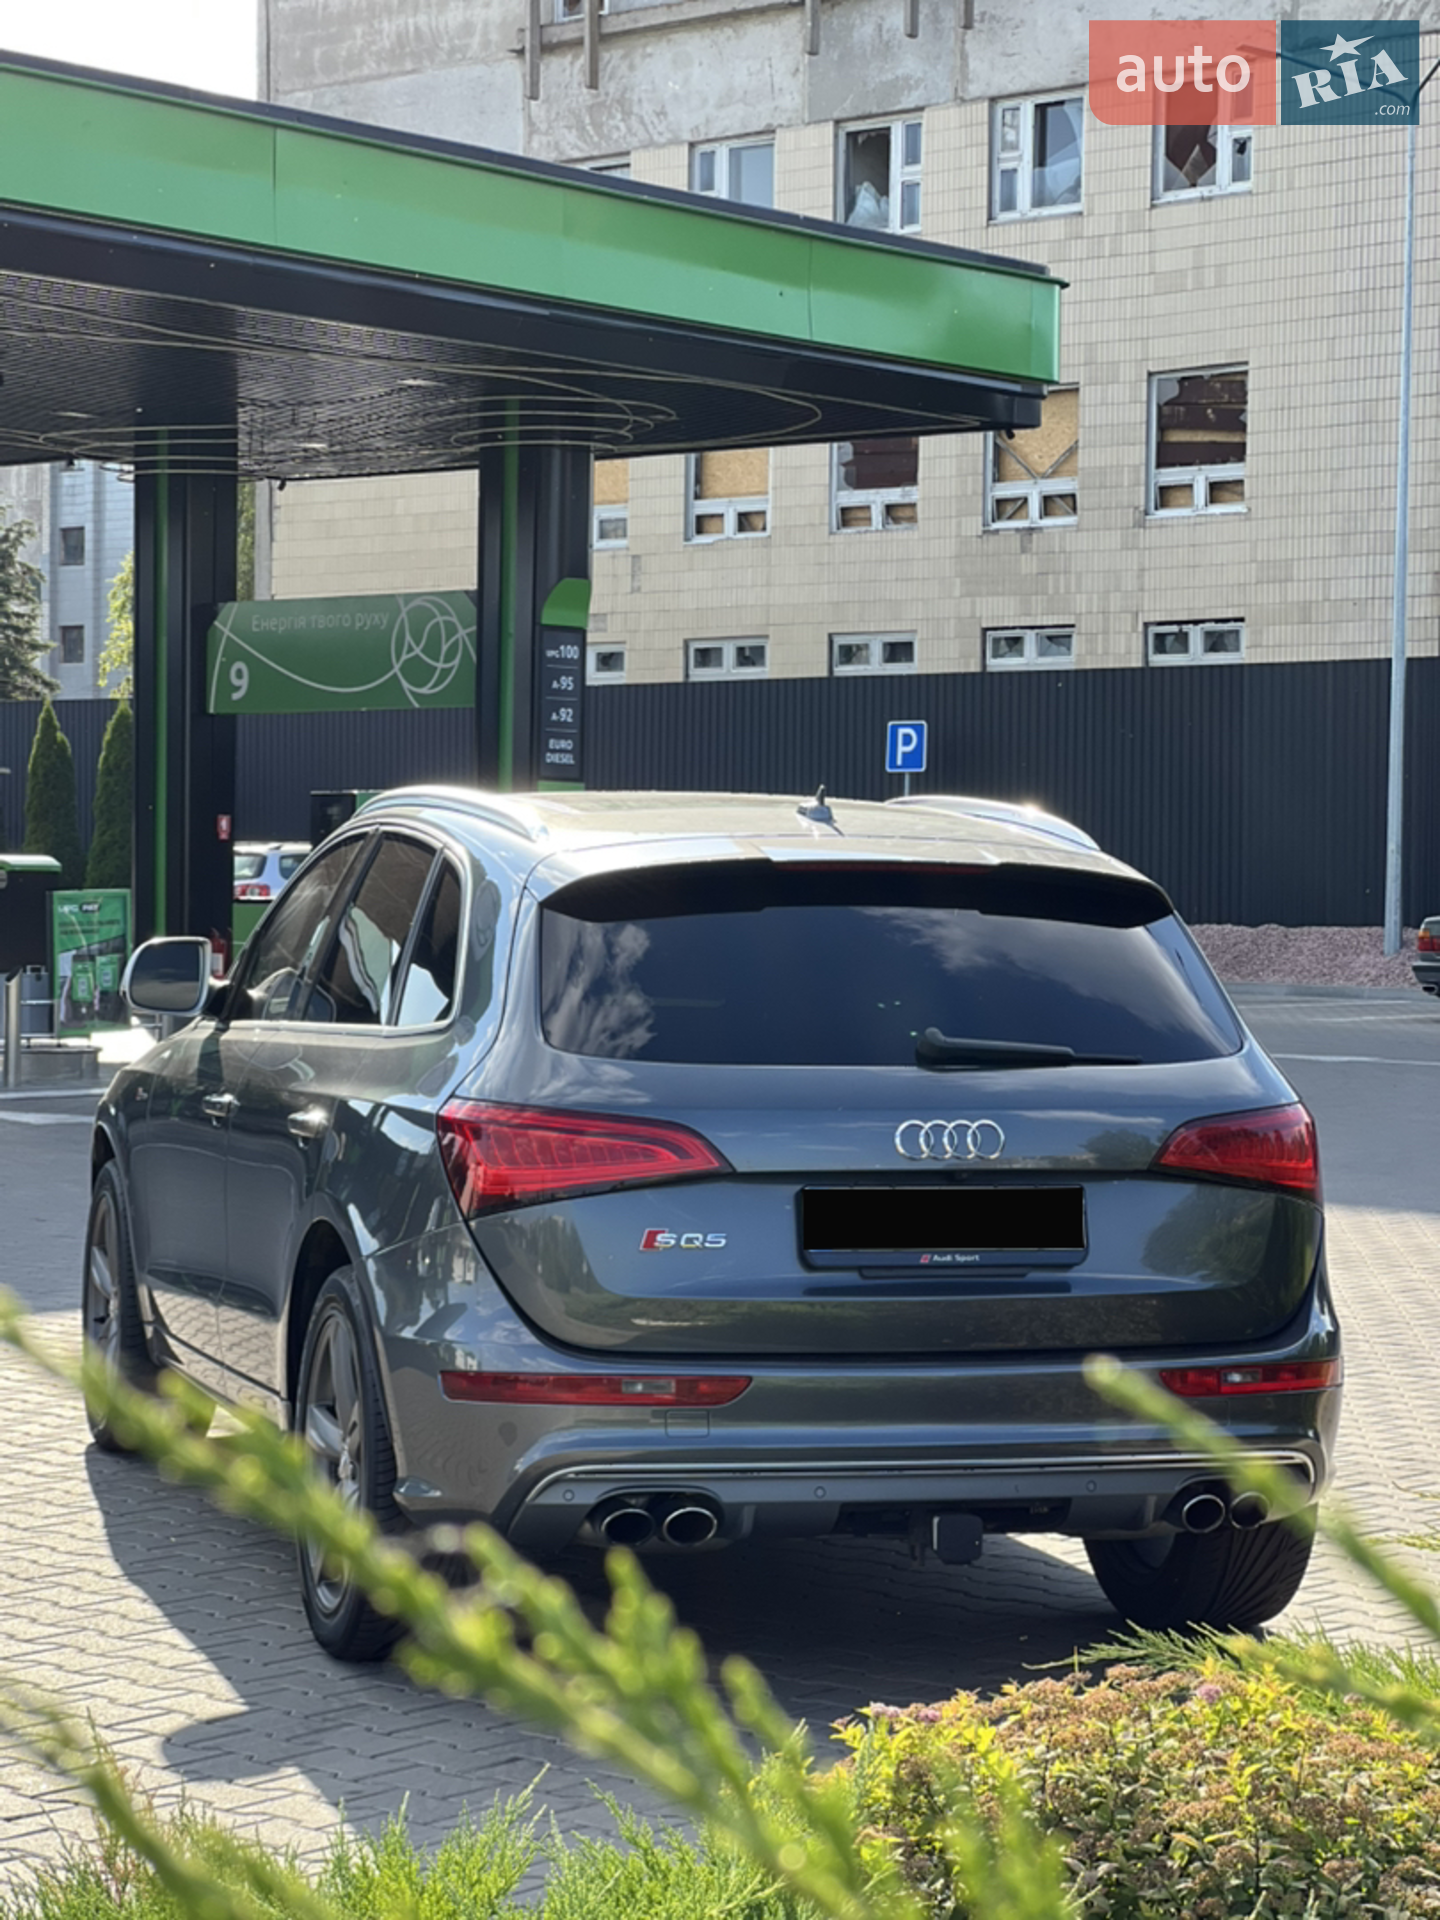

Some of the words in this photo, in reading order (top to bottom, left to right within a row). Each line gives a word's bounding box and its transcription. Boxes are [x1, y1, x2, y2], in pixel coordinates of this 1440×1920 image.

[252, 613, 306, 634] Енергія
[310, 612, 351, 629] твого
[355, 611, 390, 631] руху
[229, 661, 249, 701] 9
[548, 738, 574, 750] EURO
[896, 727, 918, 767] P
[545, 752, 575, 765] DIESEL
[652, 1231, 728, 1250] SQ5
[932, 1253, 953, 1262] Audi
[954, 1253, 980, 1263] Sport
